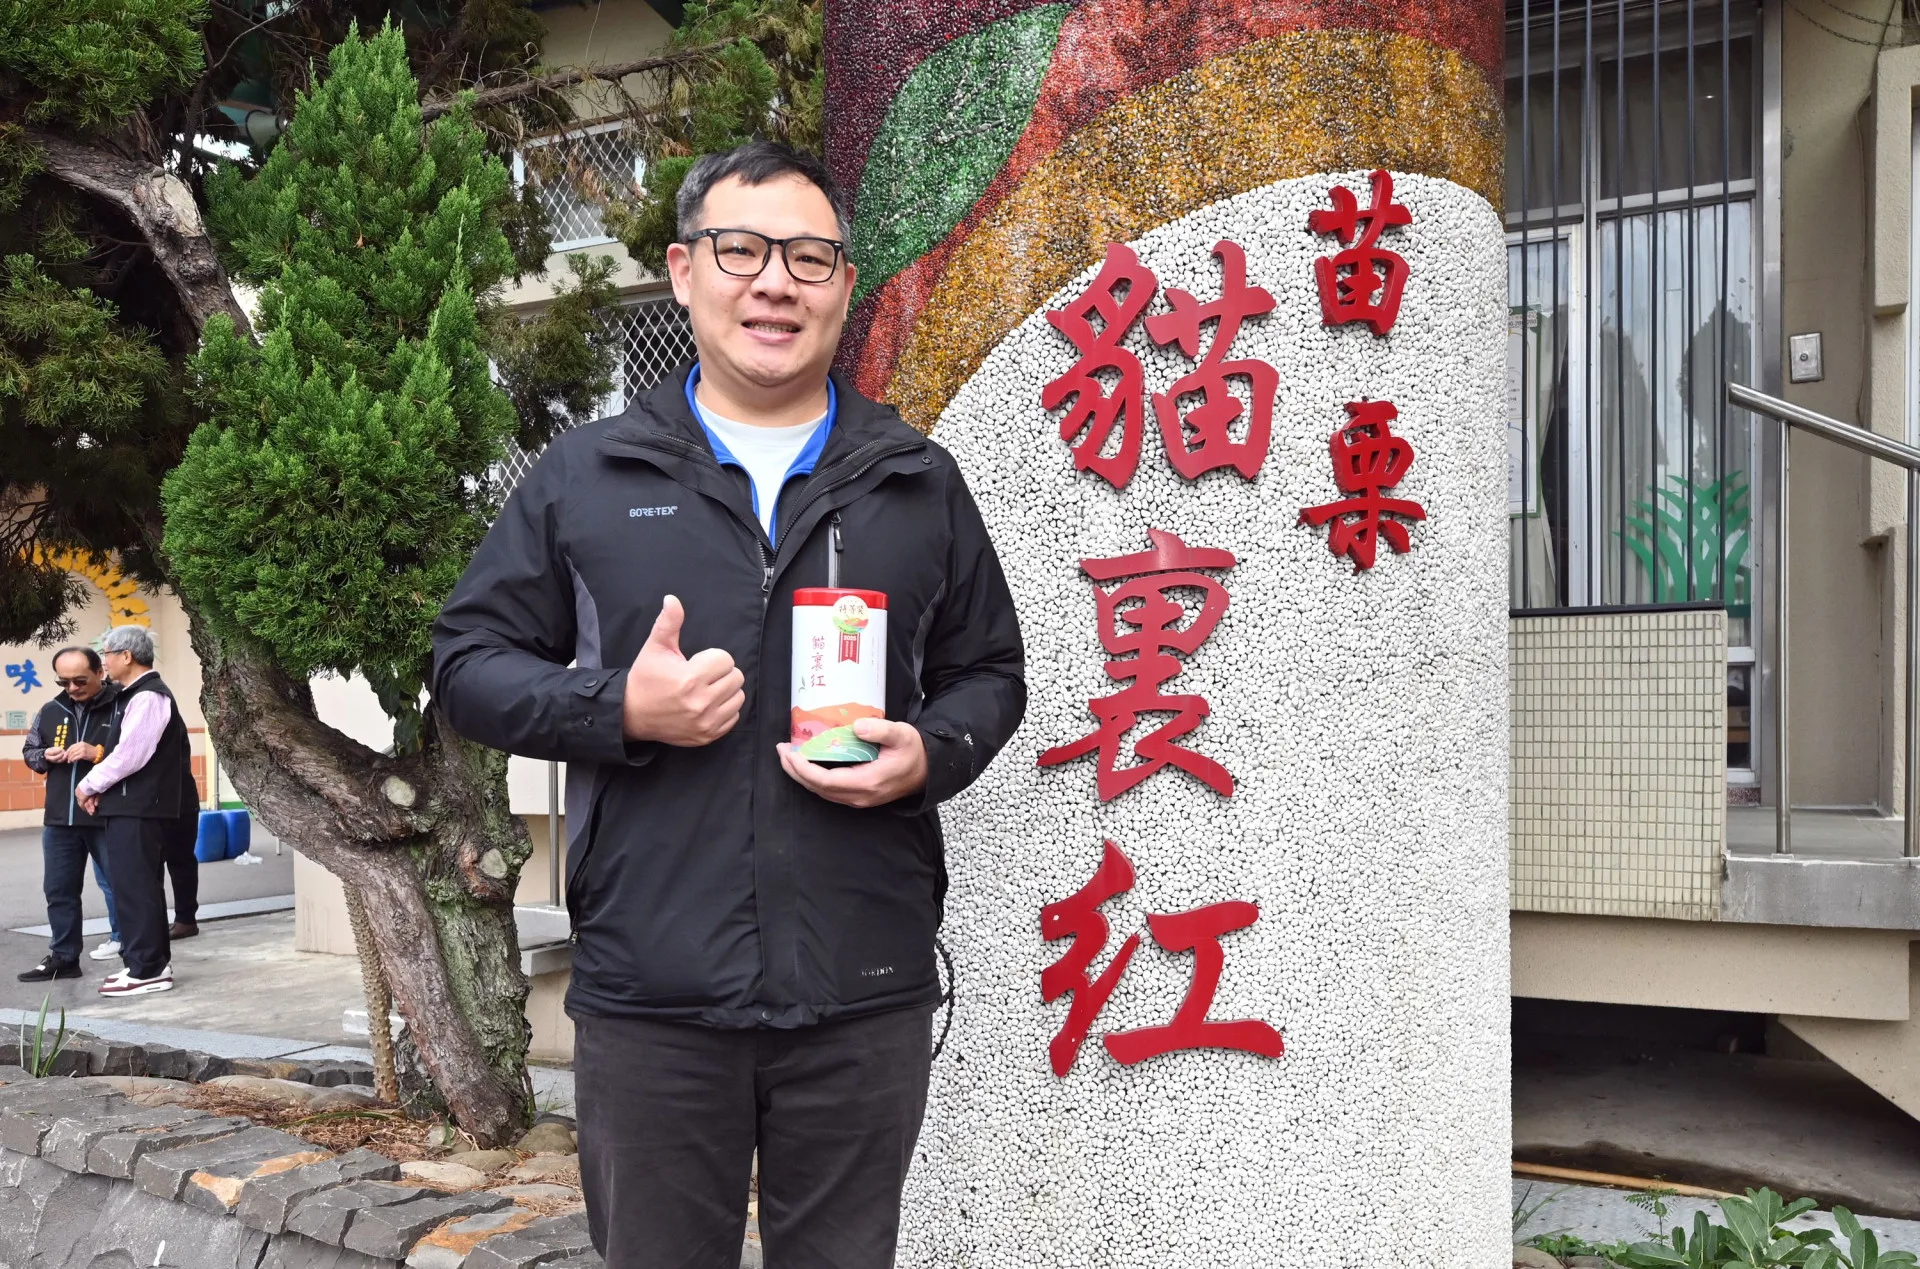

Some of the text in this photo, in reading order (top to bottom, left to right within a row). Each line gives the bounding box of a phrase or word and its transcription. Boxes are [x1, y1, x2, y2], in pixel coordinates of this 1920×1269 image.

[1300, 168, 1426, 574] 苗栗
[5, 659, 42, 694] 味
[1037, 239, 1285, 1077] 貓裏紅
